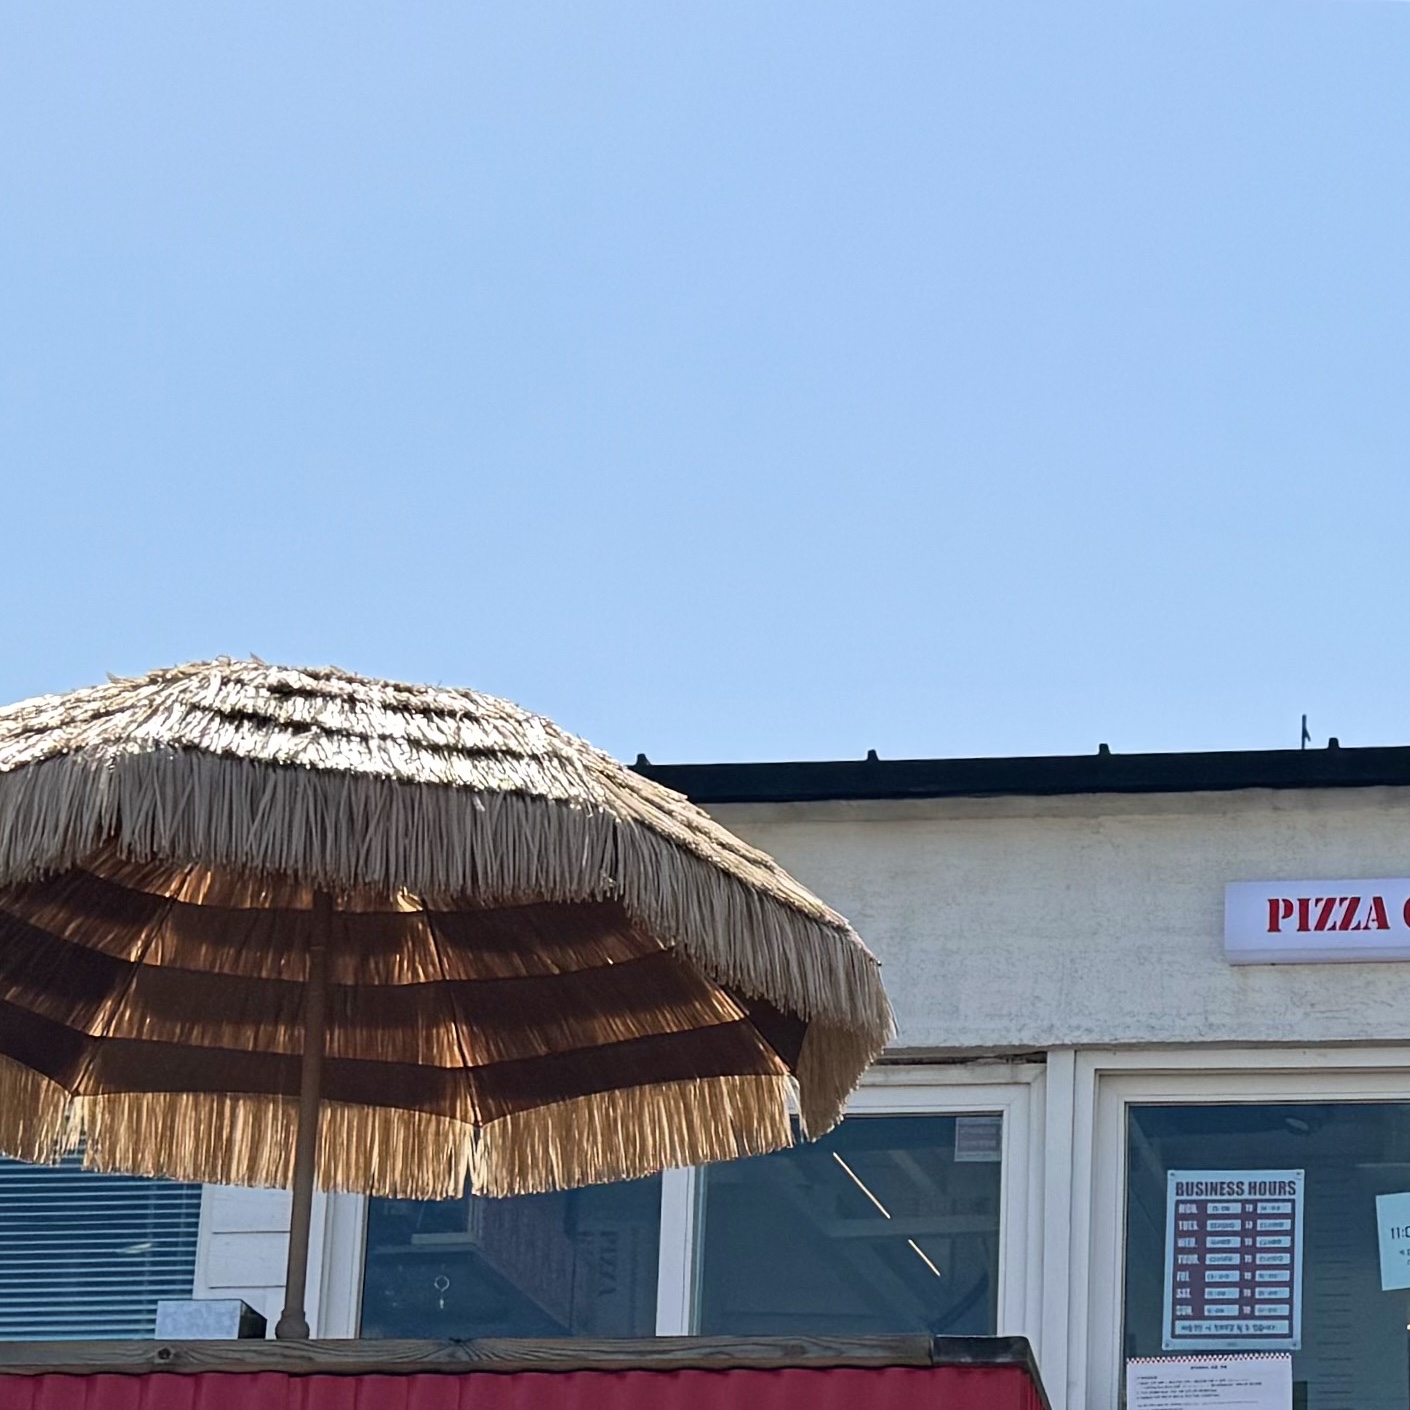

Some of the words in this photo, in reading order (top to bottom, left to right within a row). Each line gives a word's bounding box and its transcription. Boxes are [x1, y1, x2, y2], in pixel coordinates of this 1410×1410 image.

[1266, 896, 1391, 933] PIZZA
[1175, 1181, 1245, 1197] BUSINESS
[1248, 1180, 1296, 1197] HOURS
